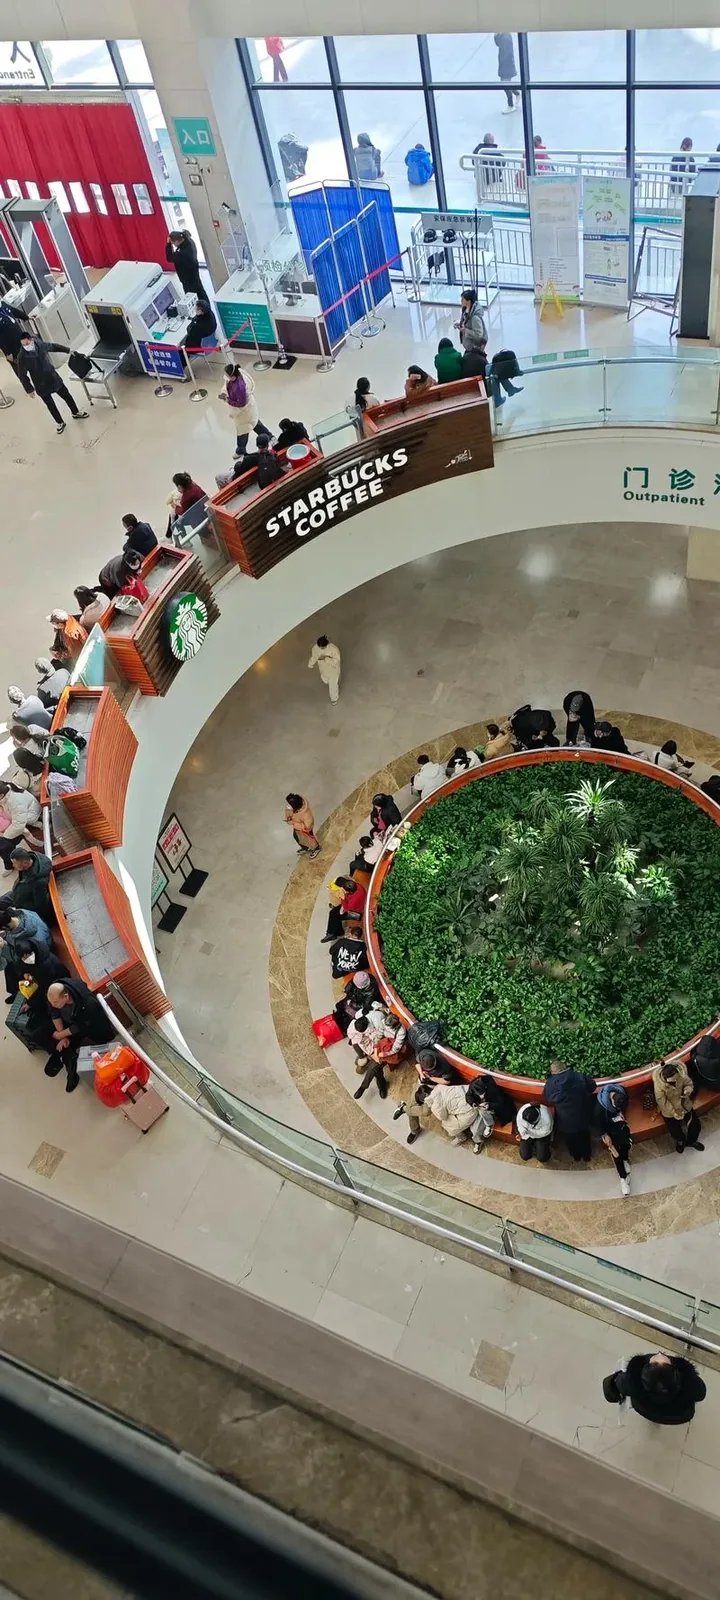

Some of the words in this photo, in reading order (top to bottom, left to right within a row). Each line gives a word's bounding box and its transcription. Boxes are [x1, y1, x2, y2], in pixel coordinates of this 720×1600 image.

[181, 128, 210, 145] 入口
[265, 447, 409, 538] STARBUCKS
[623, 490, 705, 506] Outpatient
[295, 477, 385, 537] COFFEE
[337, 946, 363, 963] NEW
[336, 957, 360, 970] YORK
